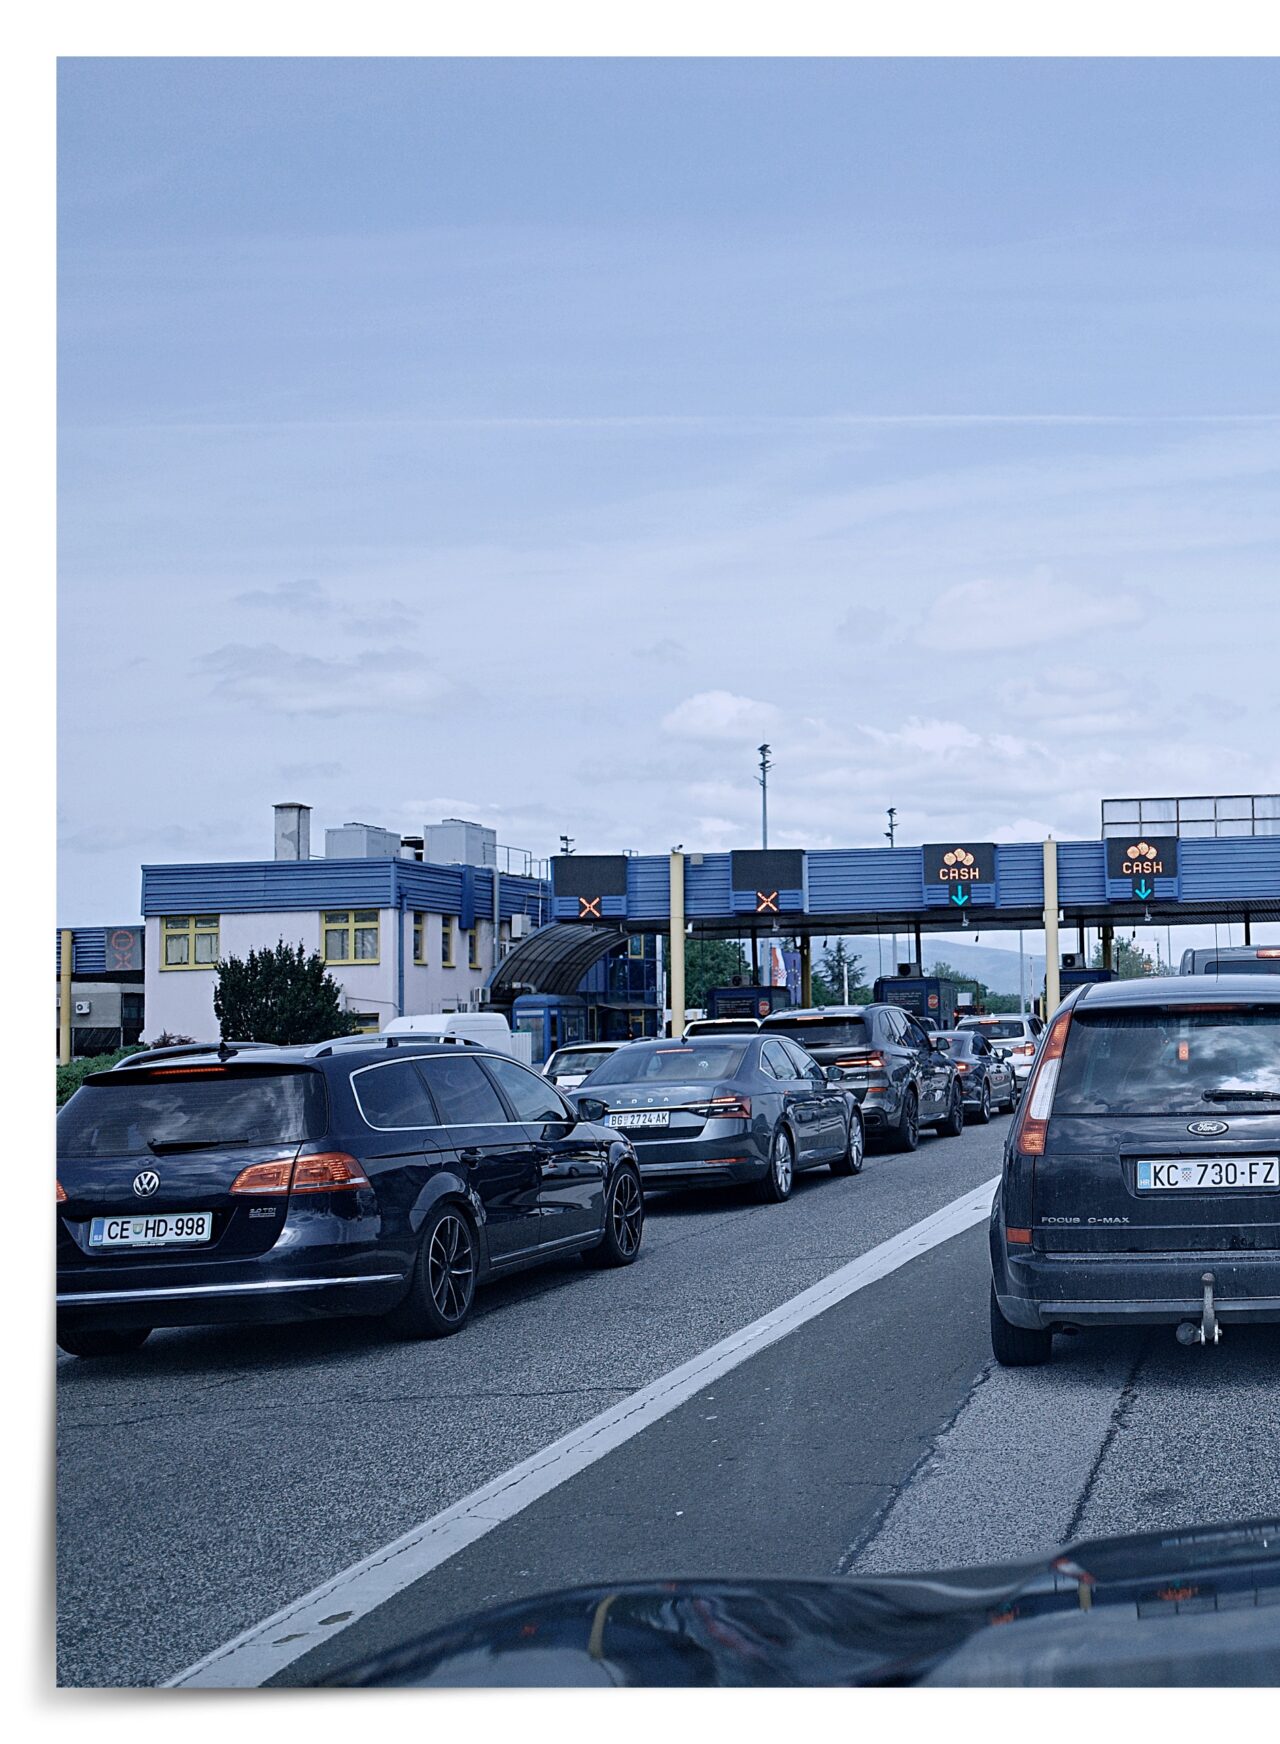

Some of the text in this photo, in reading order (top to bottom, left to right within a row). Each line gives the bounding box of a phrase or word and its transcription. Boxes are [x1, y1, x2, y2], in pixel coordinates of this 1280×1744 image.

[939, 867, 979, 880] CASH
[1122, 861, 1163, 874] CASH
[611, 1115, 624, 1126] BG
[1197, 1121, 1218, 1132] Ford
[1153, 1162, 1275, 1187] KC 730-FZ
[1041, 1216, 1131, 1224] FOCUS C-MAX
[107, 1217, 206, 1240] CE HD-998
